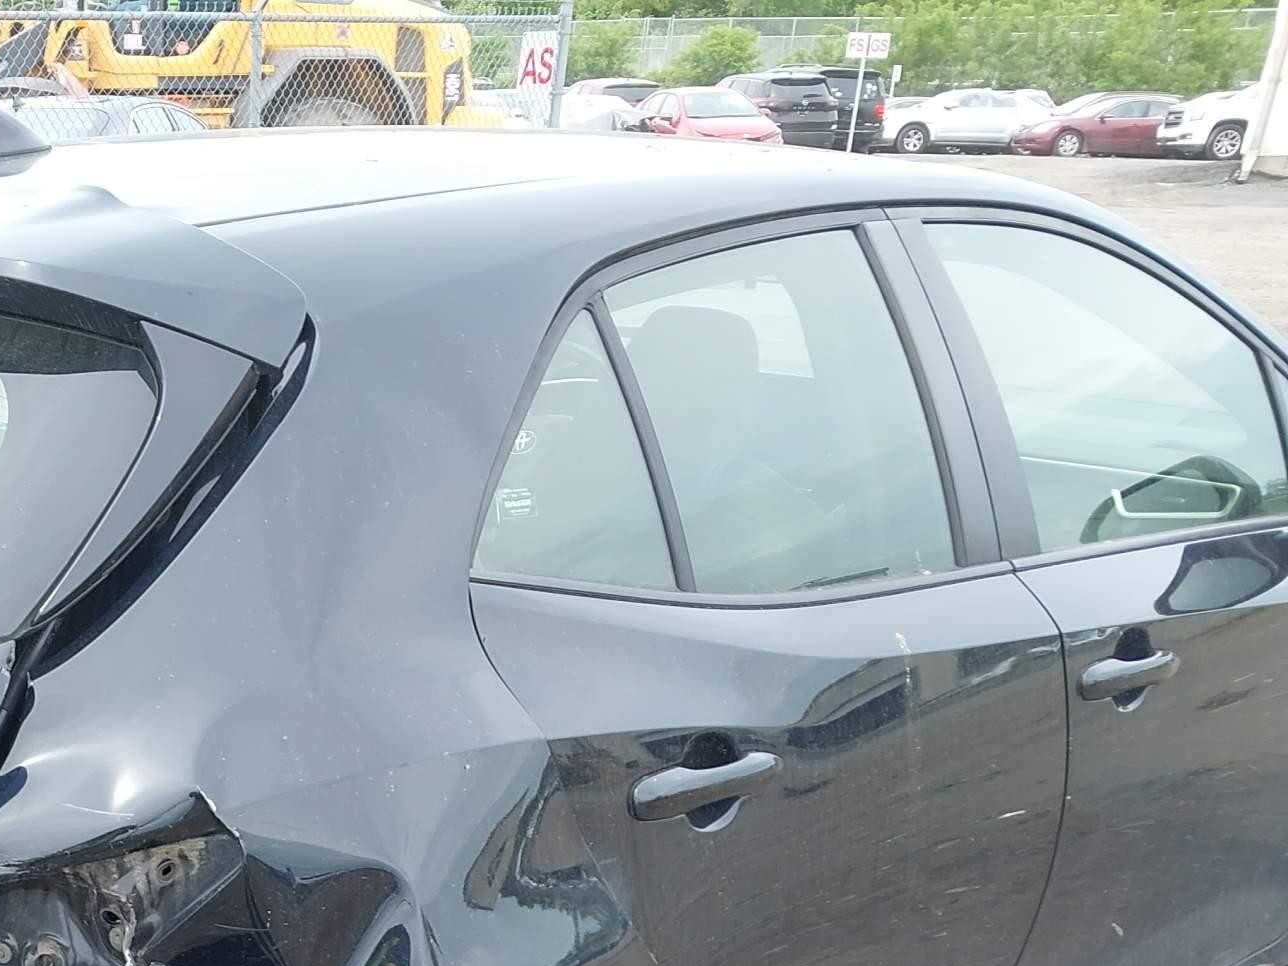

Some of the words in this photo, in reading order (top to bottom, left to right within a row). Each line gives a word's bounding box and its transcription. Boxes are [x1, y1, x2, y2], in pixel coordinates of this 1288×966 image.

[850, 38, 865, 52] FS
[870, 39, 889, 52] GS
[518, 47, 554, 86] AS
